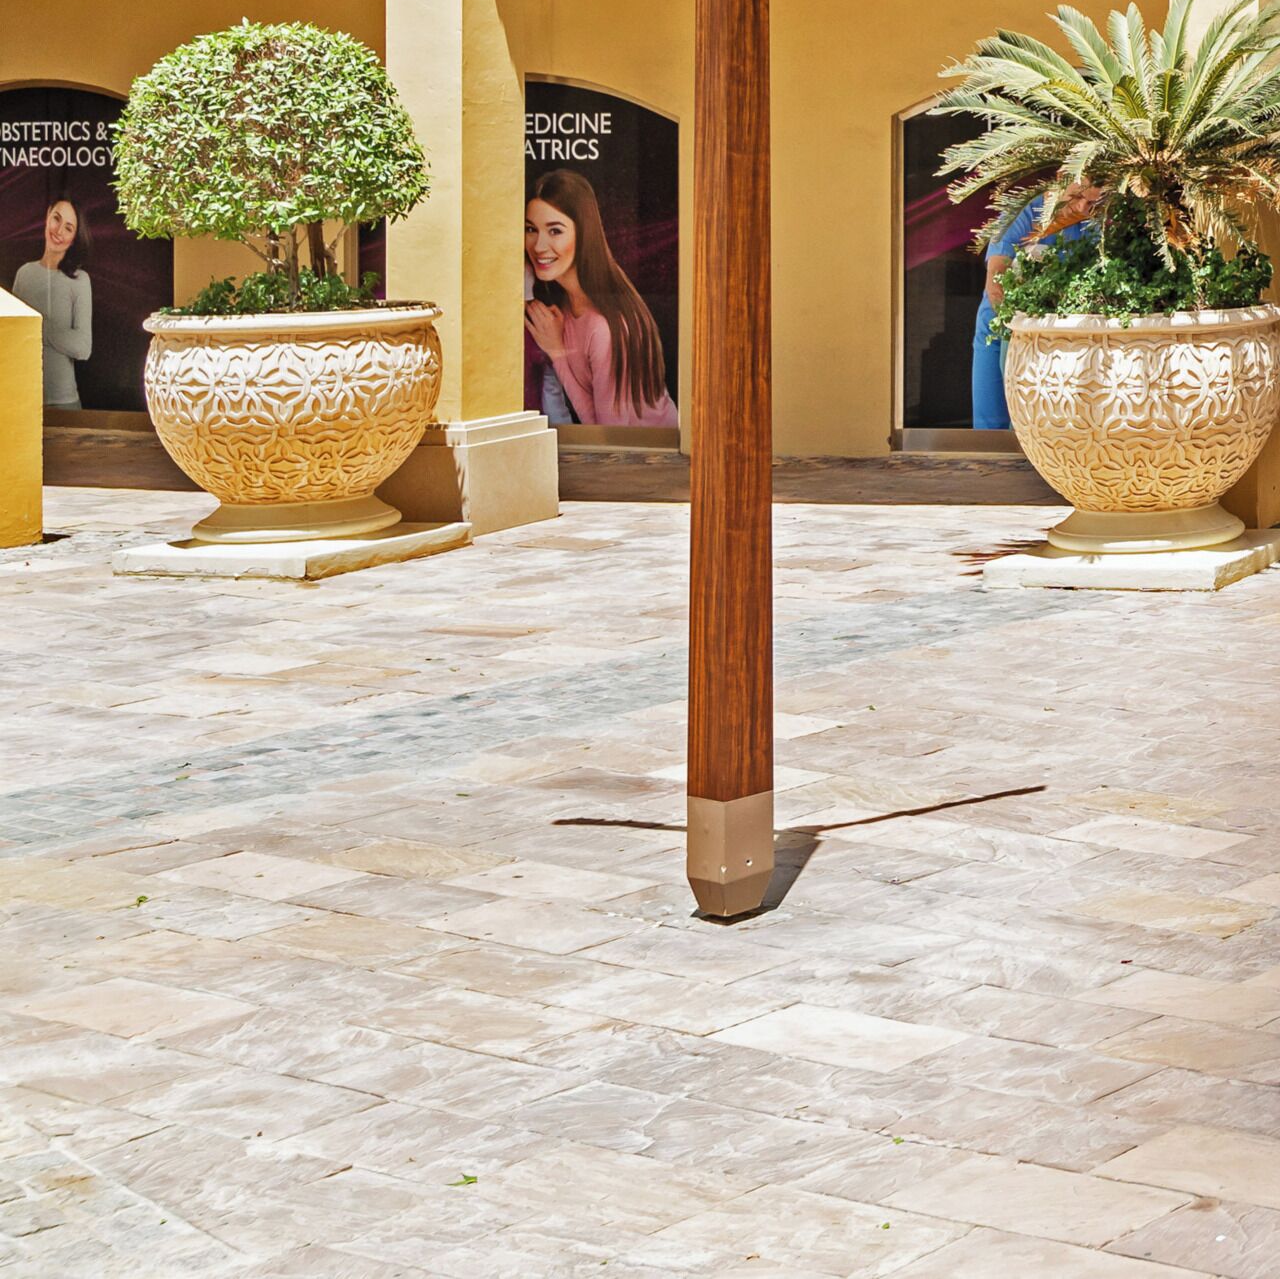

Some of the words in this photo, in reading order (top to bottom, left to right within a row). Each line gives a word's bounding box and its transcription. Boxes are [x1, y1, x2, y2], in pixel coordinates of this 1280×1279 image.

[0, 121, 91, 142] BSTETRICS
[95, 121, 108, 141] &
[0, 146, 116, 167] NAECOLOGY
